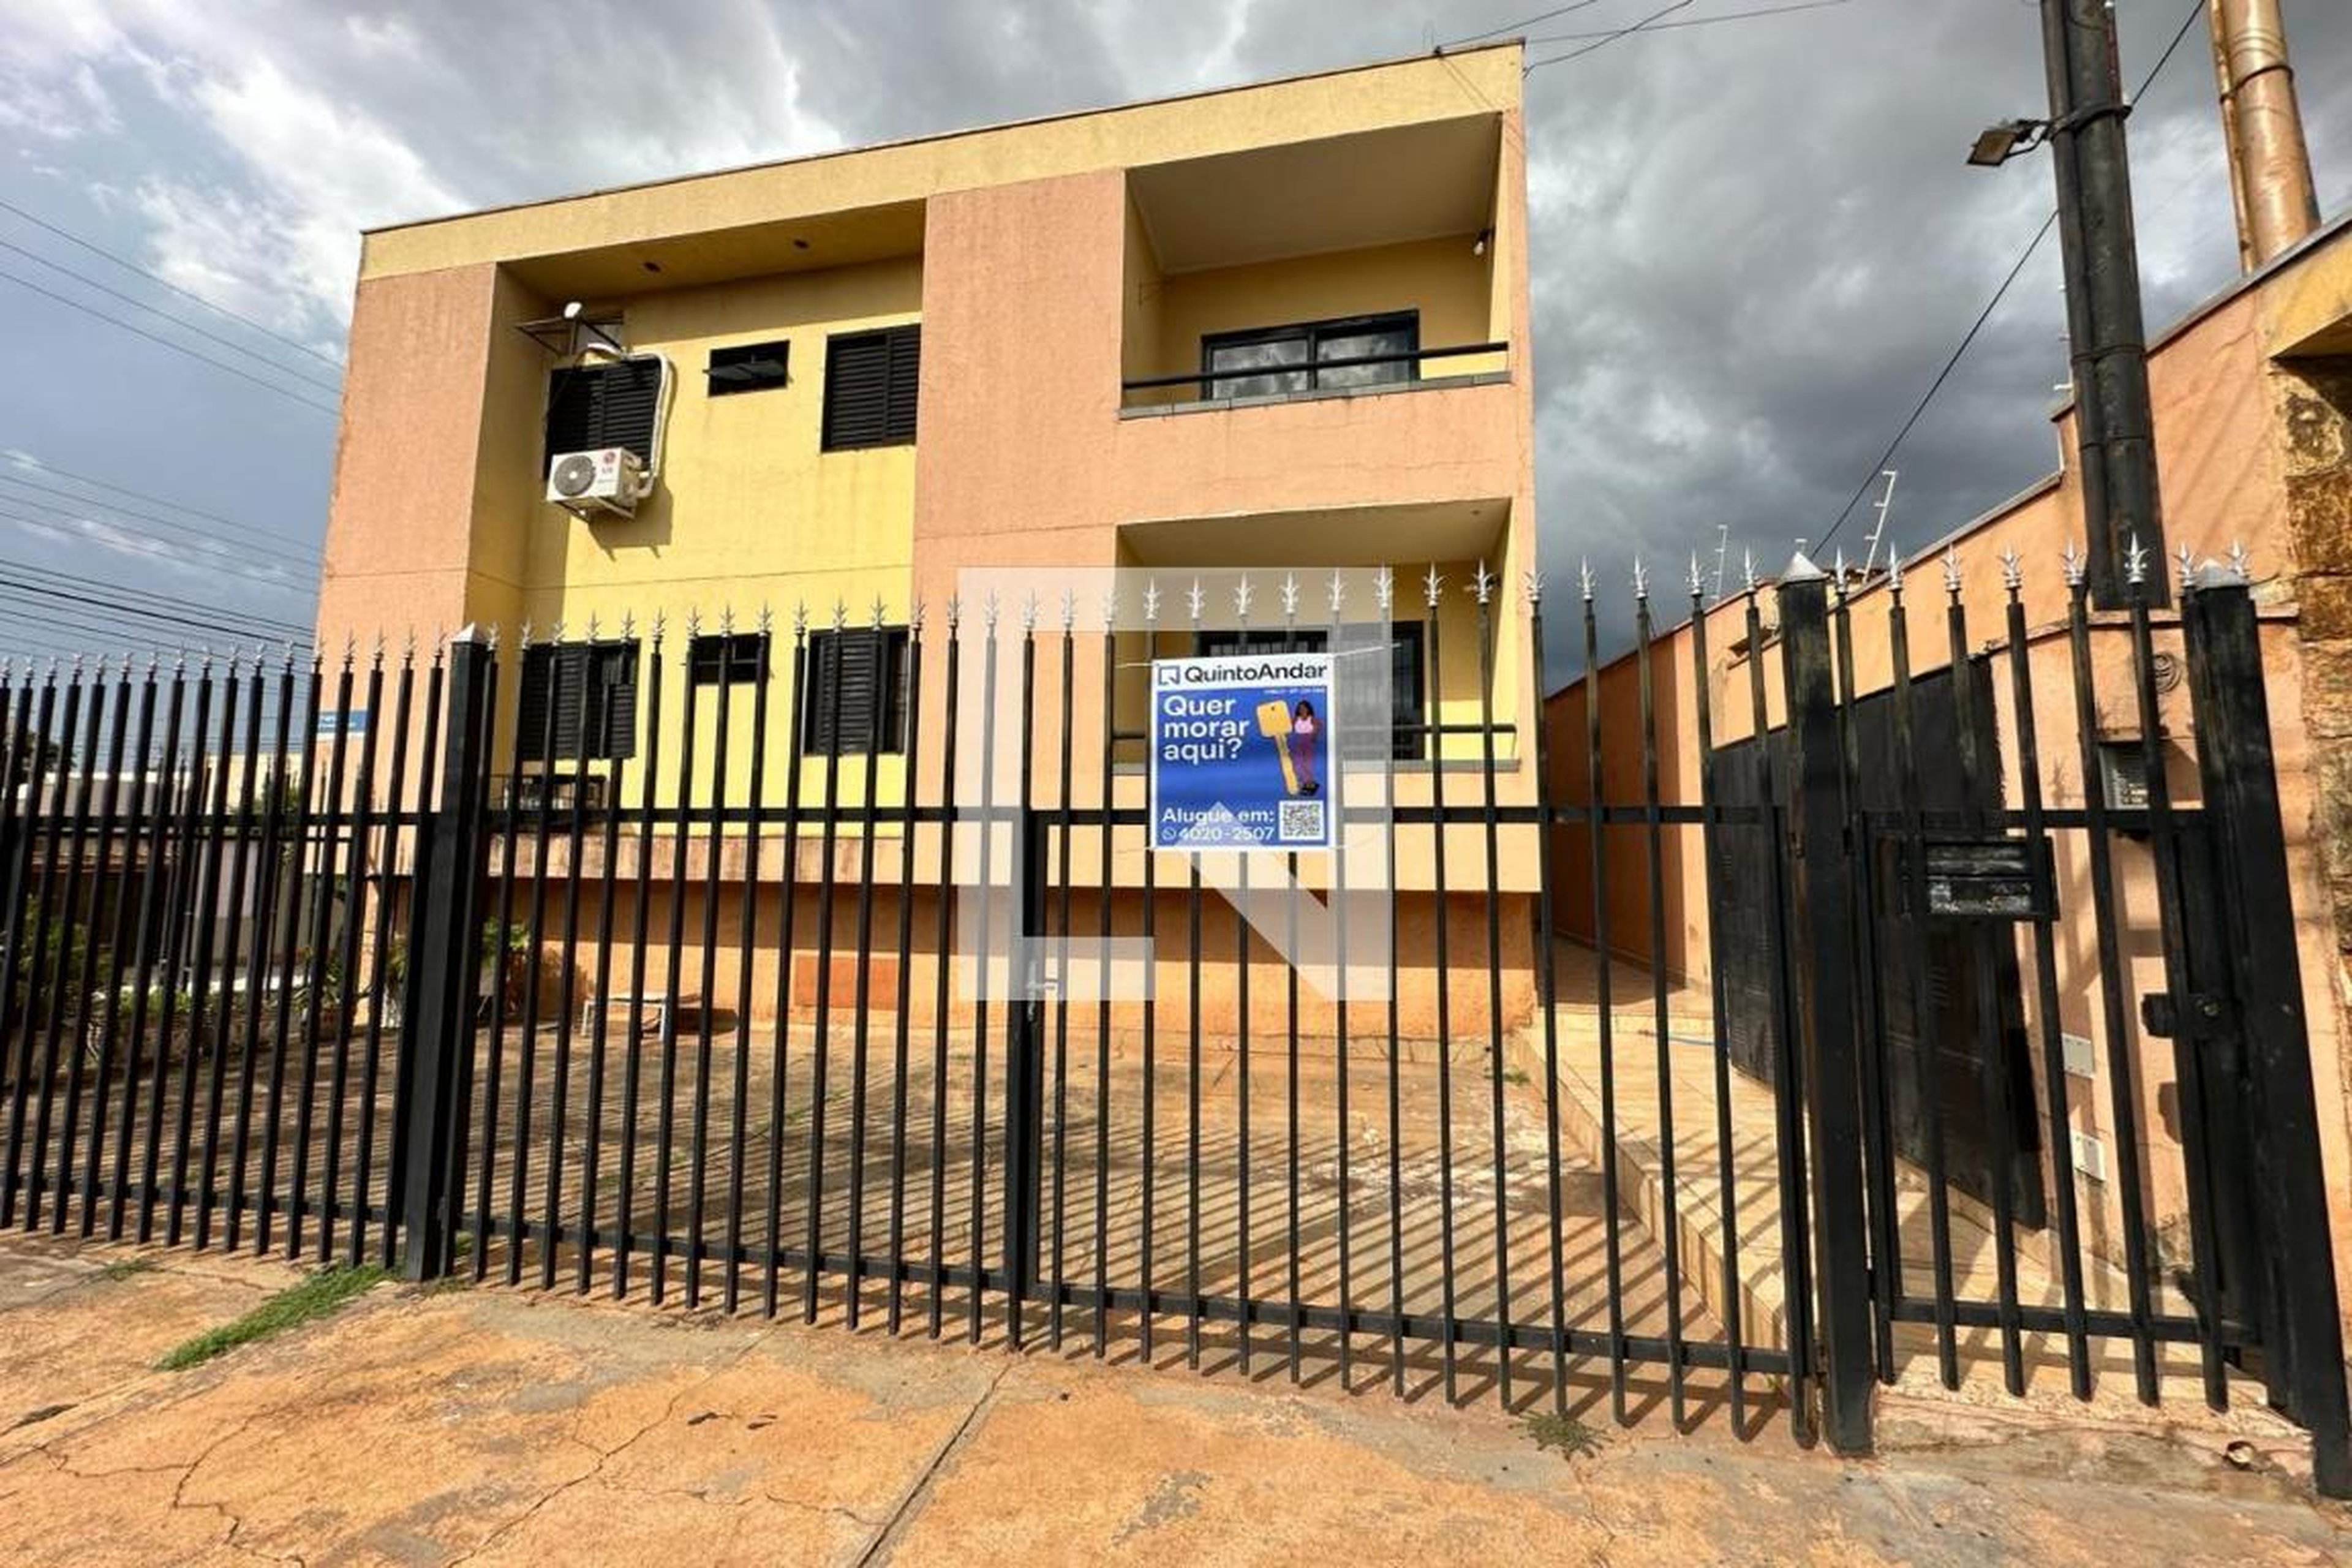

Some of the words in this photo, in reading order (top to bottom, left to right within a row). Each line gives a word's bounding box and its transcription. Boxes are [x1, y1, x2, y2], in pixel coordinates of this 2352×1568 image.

[1185, 662, 1327, 683] QuintoAndar
[1164, 695, 1236, 717] Quer
[1164, 719, 1250, 738] morar
[1164, 738, 1242, 765] aqui?
[1162, 808, 1233, 825] Alugue
[1238, 810, 1275, 823] em:
